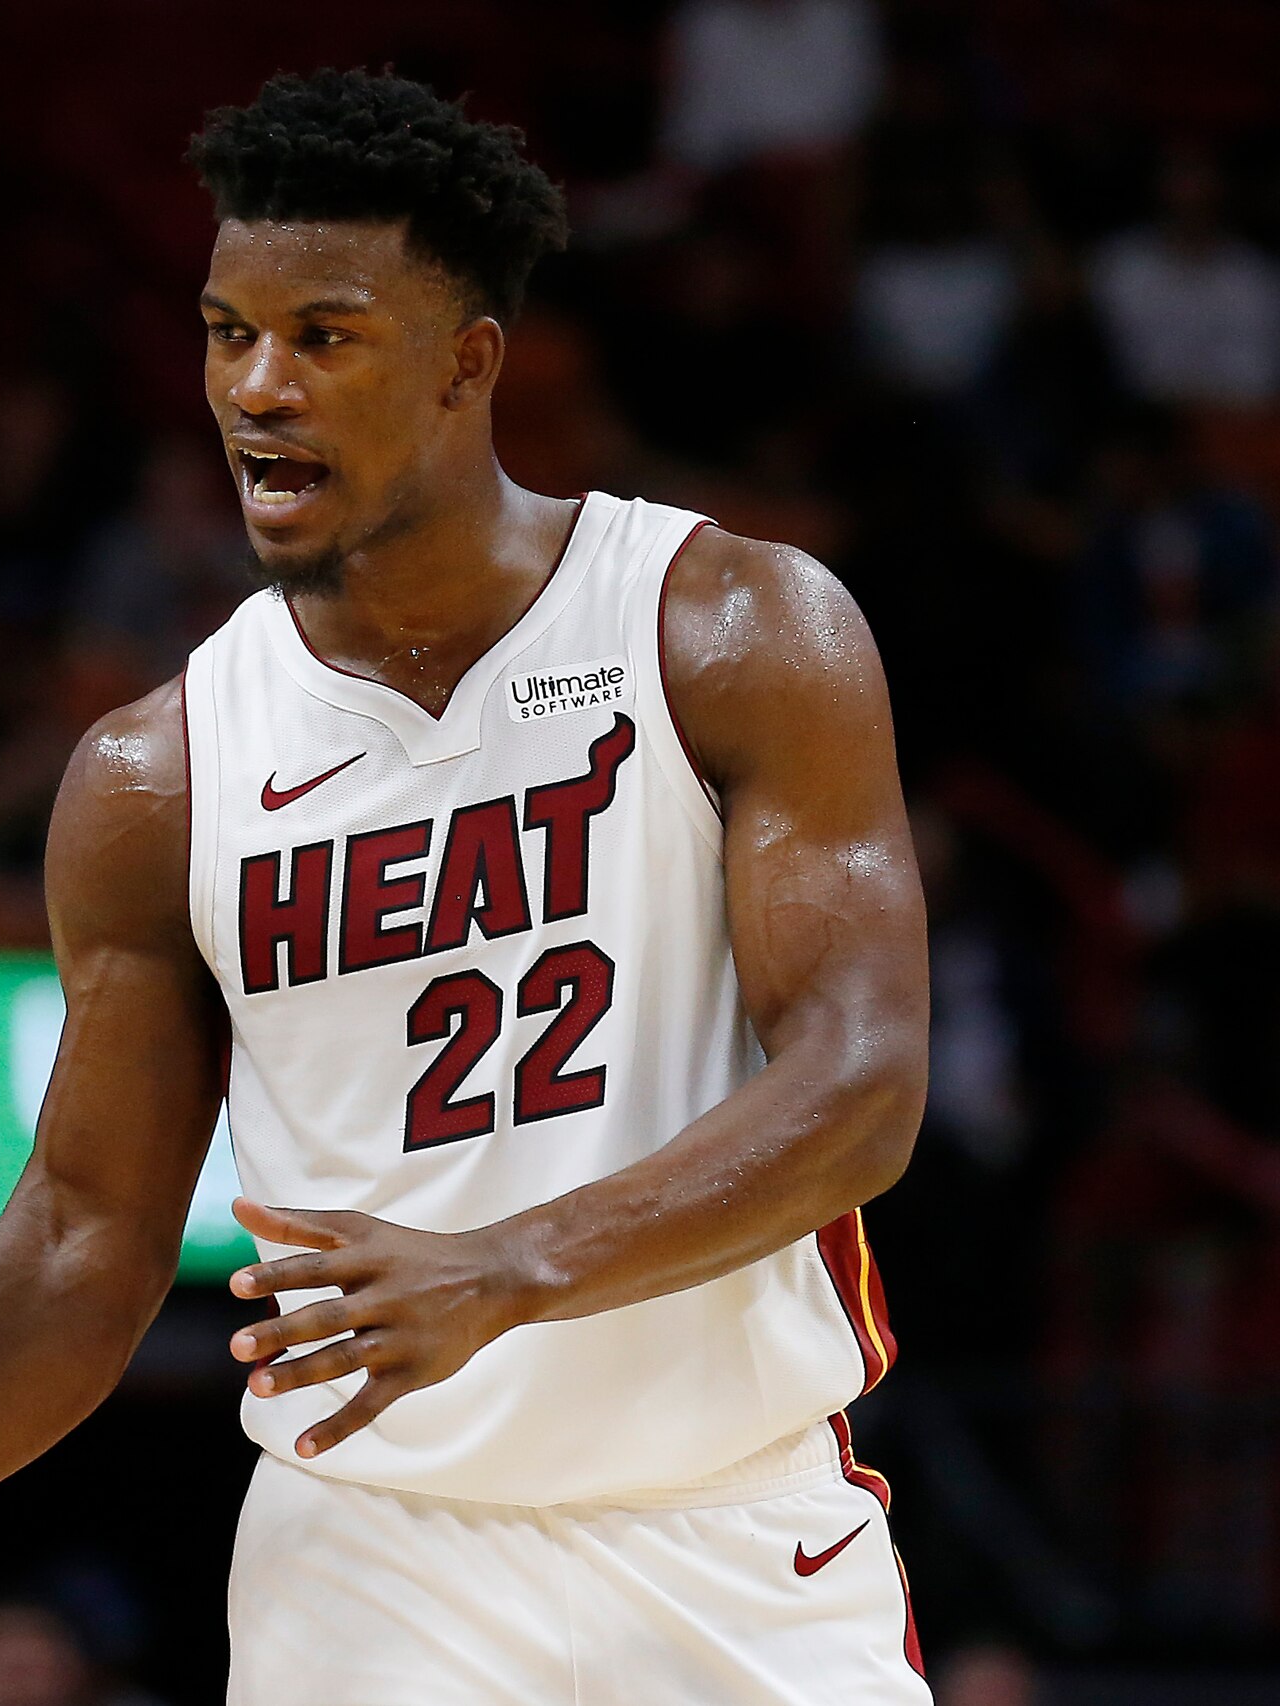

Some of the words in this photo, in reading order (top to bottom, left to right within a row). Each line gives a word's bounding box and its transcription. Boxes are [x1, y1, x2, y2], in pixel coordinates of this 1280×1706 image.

[511, 666, 625, 704] Ultimate
[521, 685, 622, 719] SOFTWARE
[238, 711, 636, 995] HEAT
[403, 939, 616, 1154] 22
